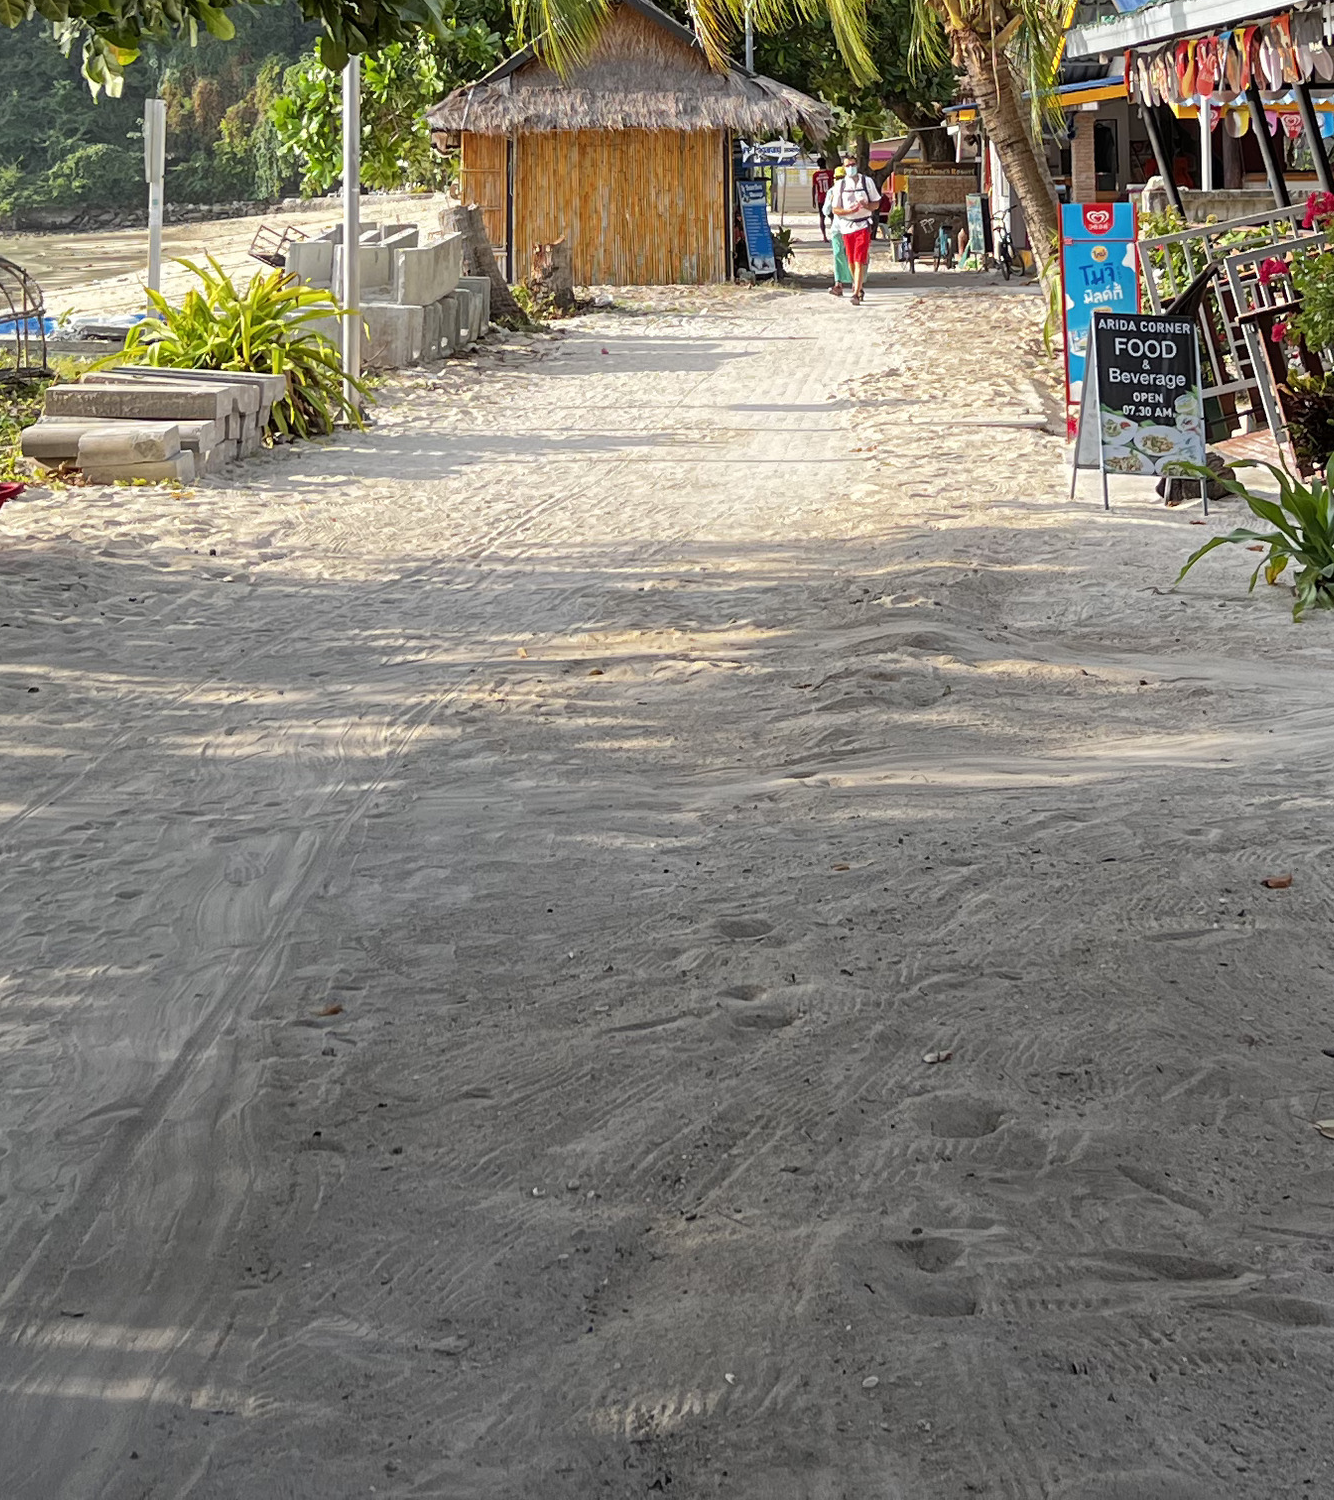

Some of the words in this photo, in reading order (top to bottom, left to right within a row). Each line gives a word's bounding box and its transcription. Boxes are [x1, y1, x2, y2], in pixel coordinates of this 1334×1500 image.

[1098, 319, 1137, 331] ARIDA
[1139, 321, 1191, 334] CORNER
[1114, 337, 1177, 358] FOOD
[1141, 359, 1151, 370] &
[1108, 367, 1186, 389] Beverage
[1132, 392, 1164, 404] OPEN
[1122, 405, 1152, 417] 07.30
